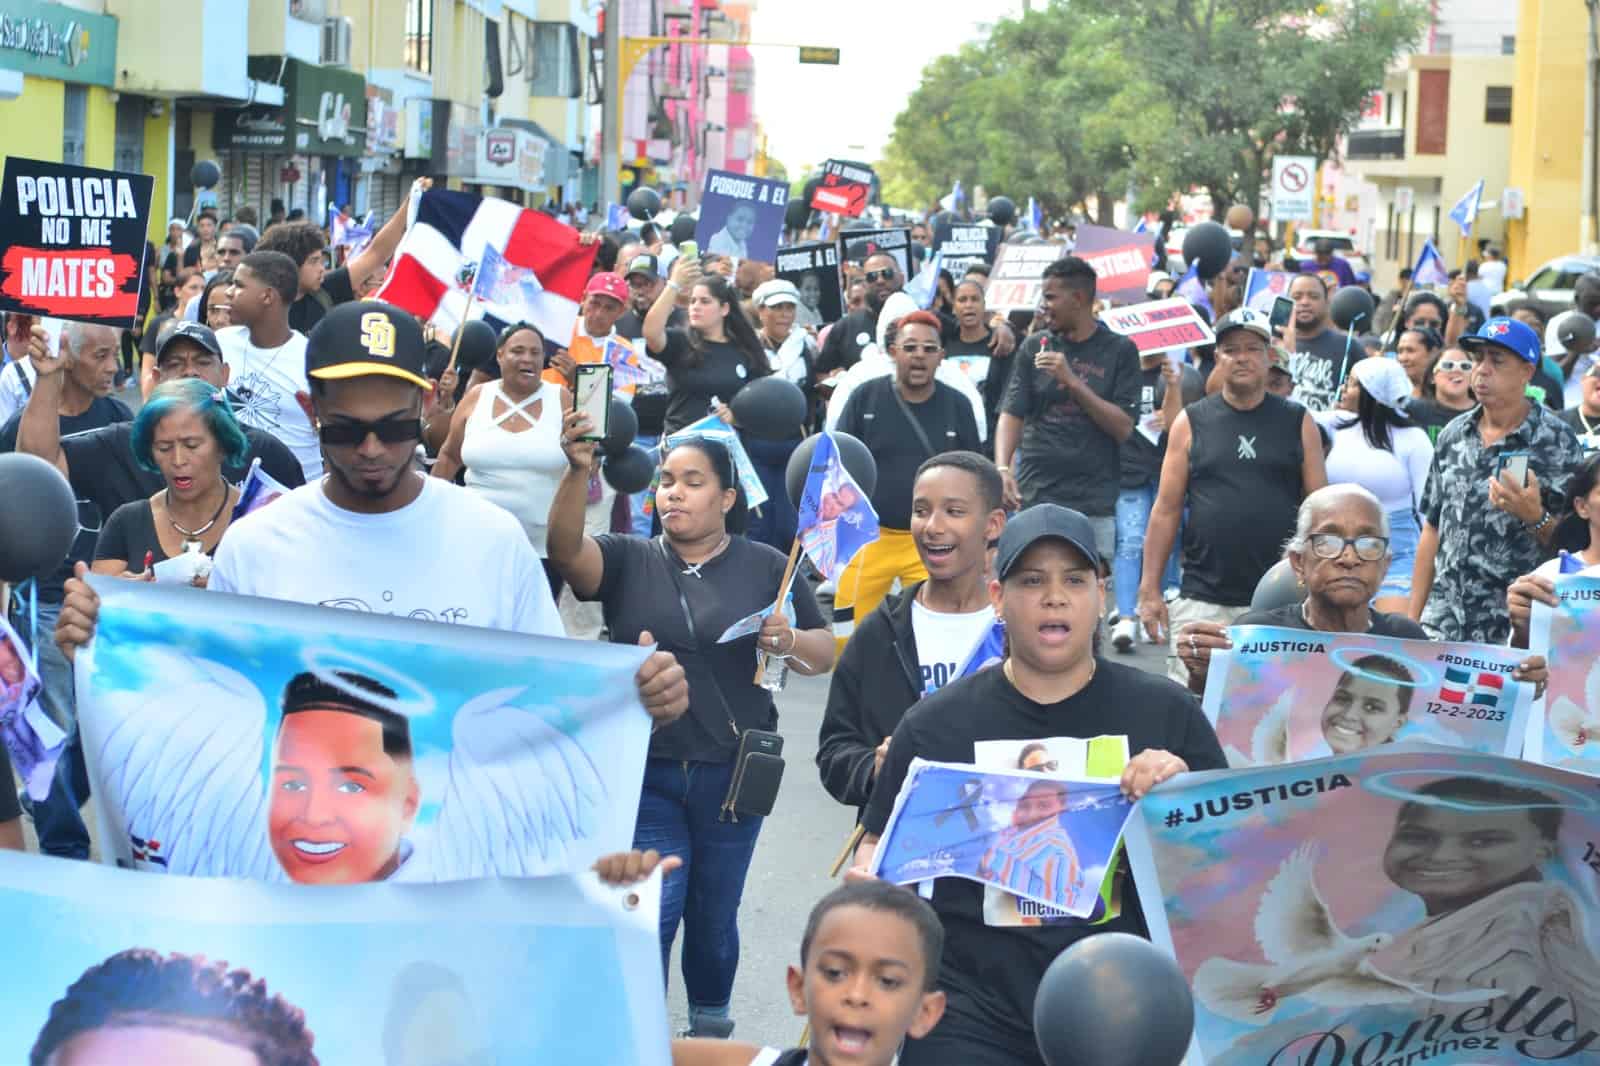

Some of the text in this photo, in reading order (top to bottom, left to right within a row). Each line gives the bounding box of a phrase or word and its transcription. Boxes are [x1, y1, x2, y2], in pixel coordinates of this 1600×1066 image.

[17, 175, 137, 218] POLICIA
[710, 175, 786, 206] PORQUE A EL
[42, 217, 112, 245] NO ME
[816, 249, 824, 266] A
[21, 257, 115, 299] MATES
[1240, 641, 1326, 655] #JUSTICIA
[1437, 653, 1515, 673] #RDDELUTO
[1426, 702, 1507, 721] 12-2-2023
[1165, 773, 1352, 828] #JUSTICIA
